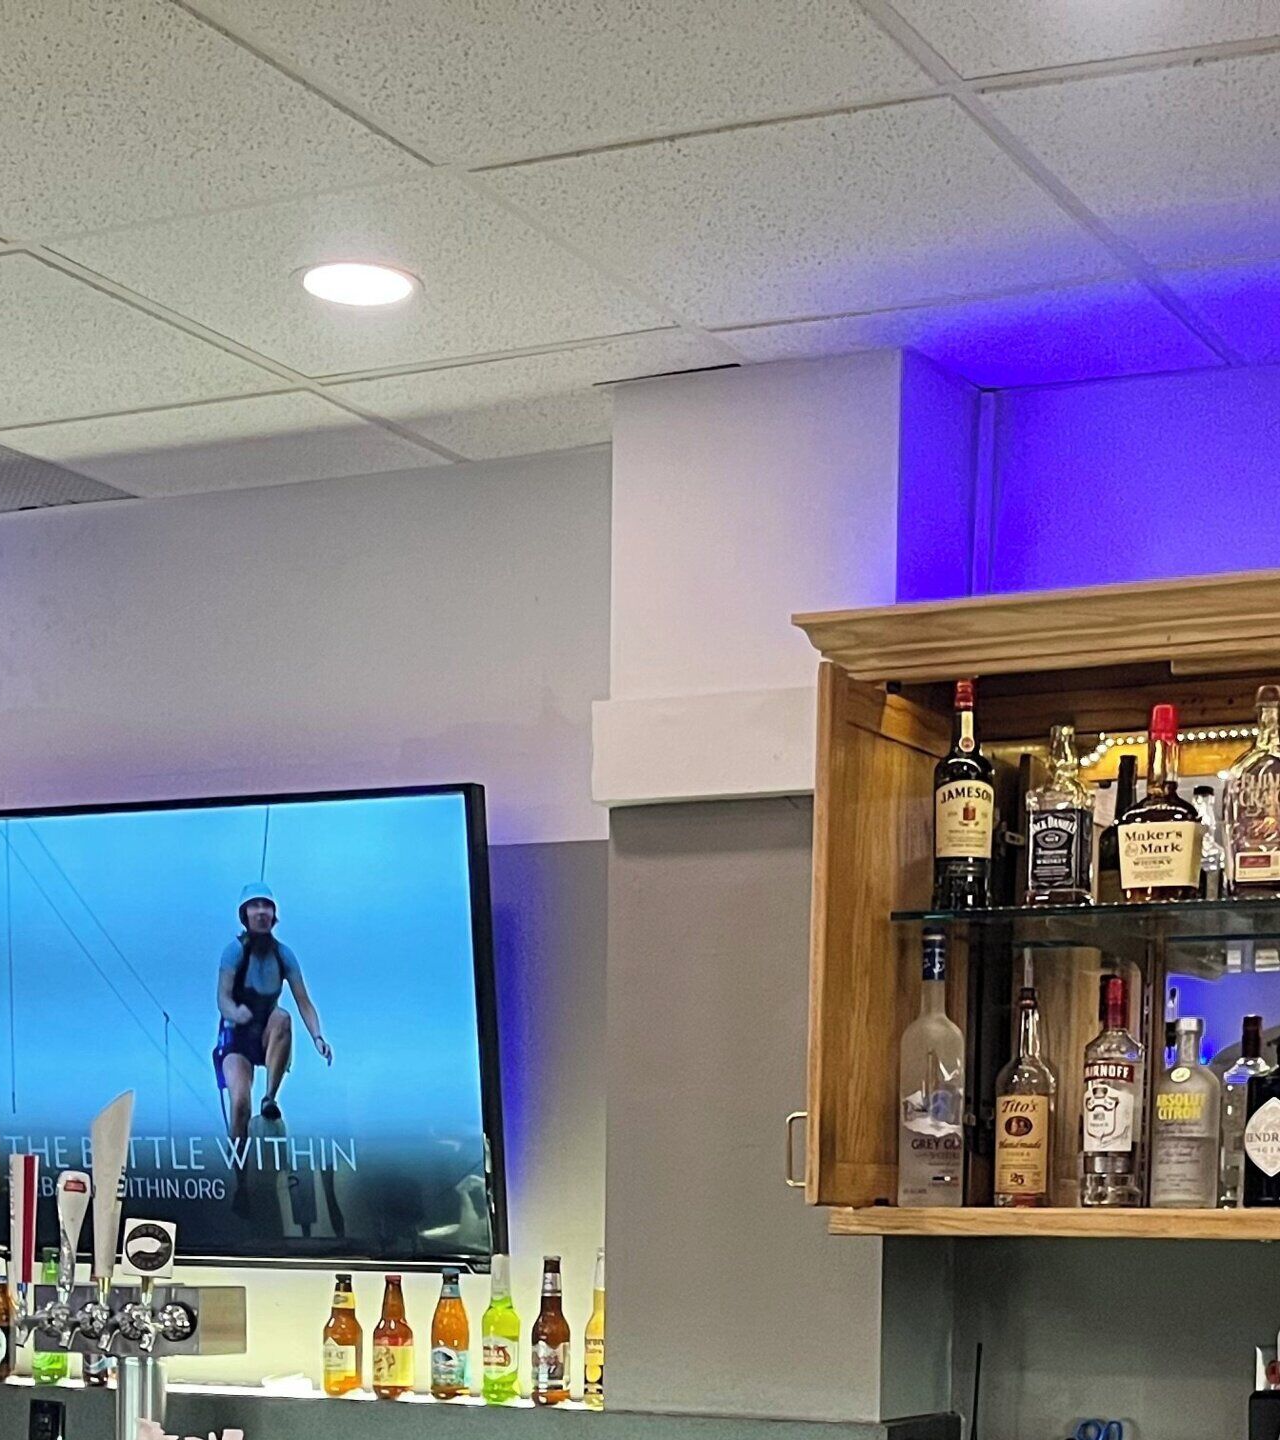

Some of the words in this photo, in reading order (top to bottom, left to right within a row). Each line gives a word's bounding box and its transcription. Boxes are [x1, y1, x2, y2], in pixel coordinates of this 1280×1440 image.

[941, 786, 992, 804] JAMESON
[1124, 829, 1183, 843] Maker's
[1140, 842, 1182, 855] Mark
[1084, 1064, 1130, 1079] MIRNOFF
[1001, 1099, 1038, 1113] Tito's
[1157, 1093, 1206, 1107] ABSOLUT
[1158, 1106, 1202, 1120] CITRON
[911, 1137, 941, 1150] GREY
[3, 1136, 70, 1168] THE
[82, 1136, 206, 1170] BTTLE
[218, 1136, 358, 1172] WITHIN
